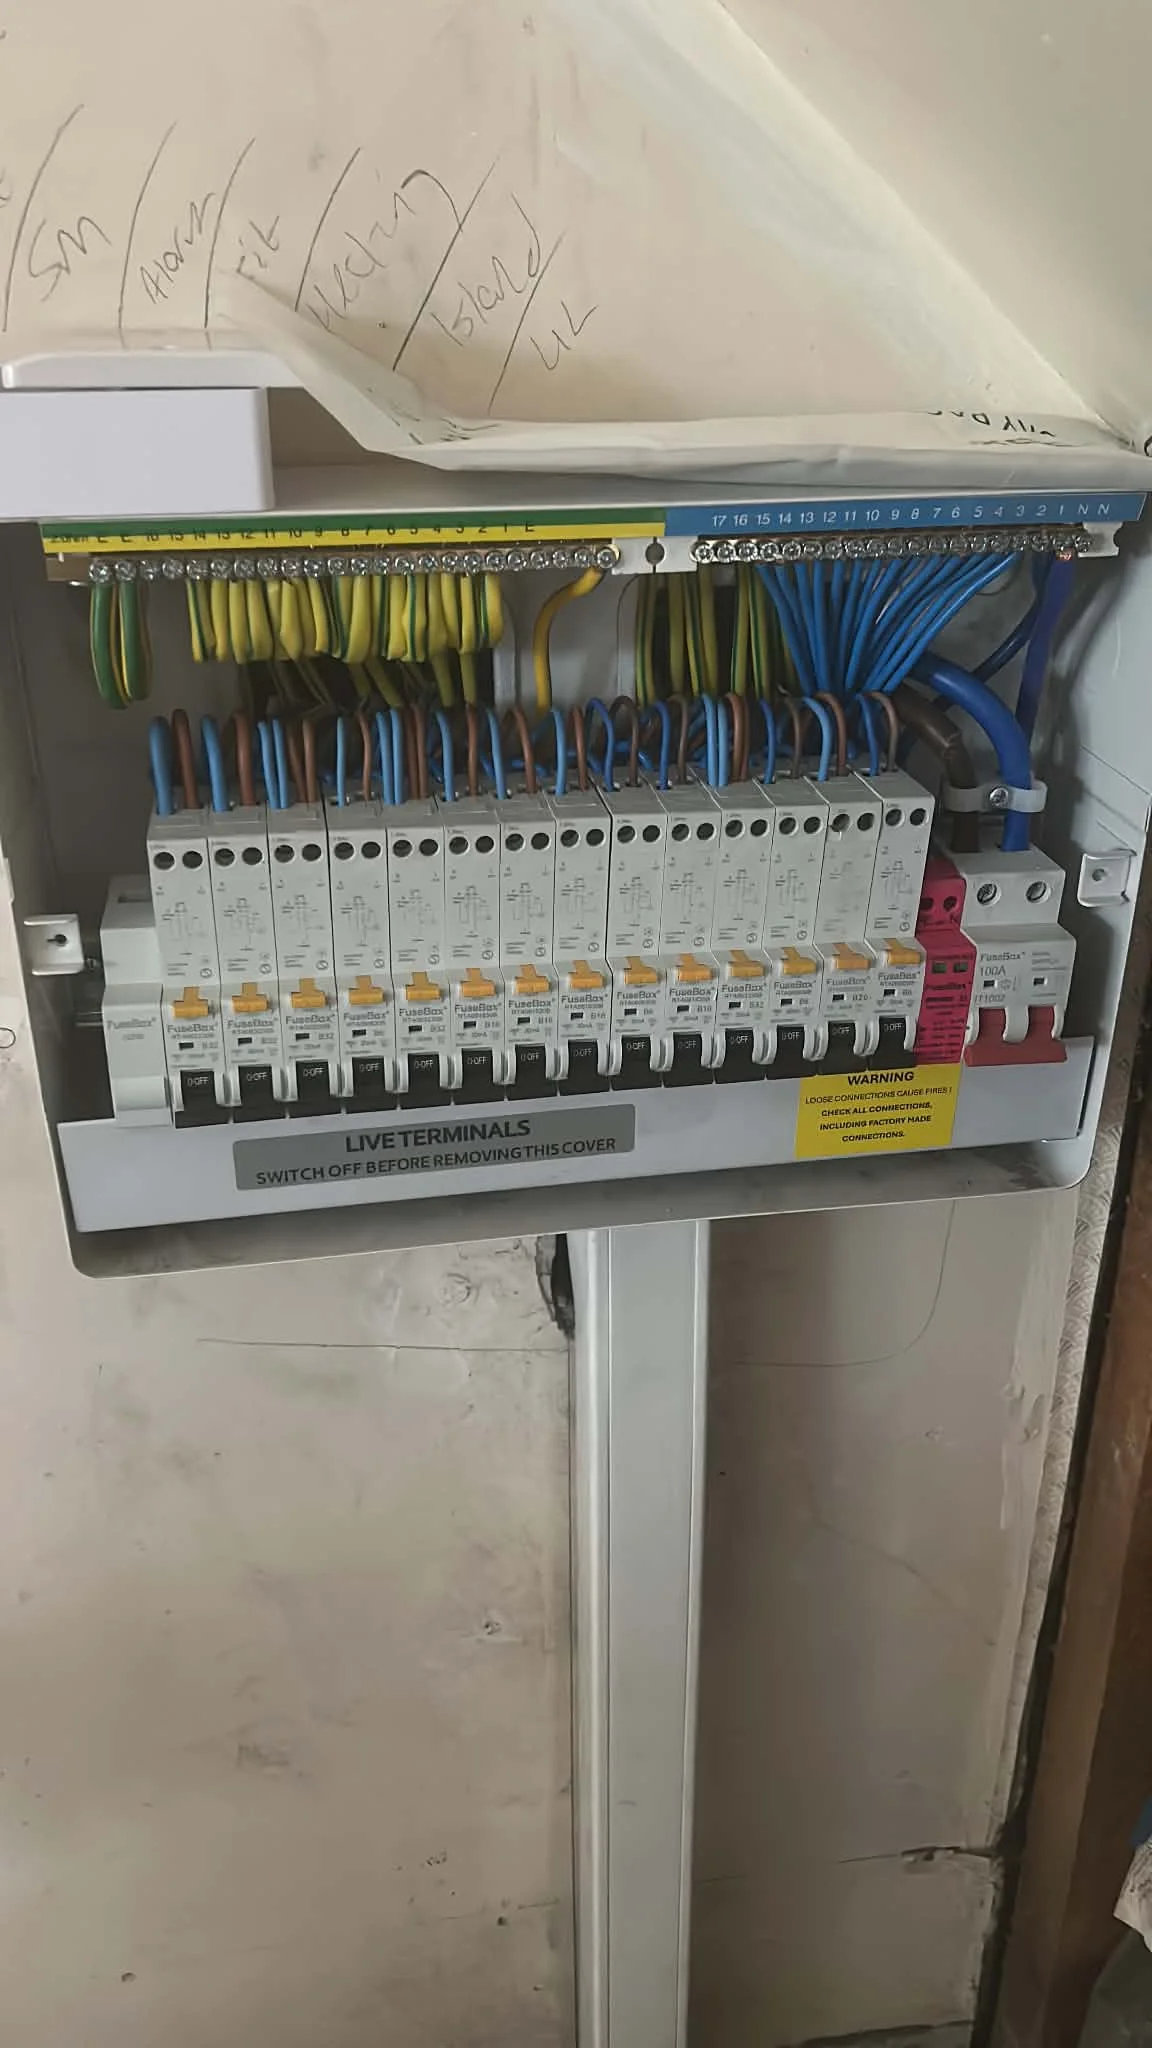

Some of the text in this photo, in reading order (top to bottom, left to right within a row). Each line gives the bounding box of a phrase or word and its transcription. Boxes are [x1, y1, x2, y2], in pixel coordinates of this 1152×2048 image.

[712, 514, 726, 527] 17
[733, 514, 748, 526] 16
[757, 513, 770, 525] 15
[779, 512, 792, 524] 14
[801, 511, 814, 524] 13
[823, 511, 837, 523] 12
[844, 510, 856, 521] 11
[866, 509, 880, 521] 10
[891, 509, 900, 520] 9
[911, 508, 920, 519] 8
[932, 507, 941, 518] 7
[952, 506, 960, 518] 6
[973, 505, 983, 517] 5
[1016, 504, 1025, 516] 3
[1036, 504, 1047, 516] 2
[1078, 503, 1089, 514] N
[1098, 503, 1110, 514] N
[980, 965, 1007, 977] 100A
[399, 1007, 443, 1017] FuseBox
[848, 1071, 915, 1086] WARNING
[805, 1095, 834, 1105] LOOSE
[834, 1090, 896, 1104] CONNECTIONS
[896, 1087, 925, 1097] CAUSE
[925, 1086, 948, 1096] FIRES
[821, 1107, 850, 1117] CHECK
[852, 1106, 867, 1115] ALL
[820, 1114, 932, 1131] INCLUDING FACTORY MADE
[345, 1119, 531, 1153] LIVE TERMINALS
[255, 1136, 617, 1185] SWITCH OFF BEFORE REMOVING THIS COVER
